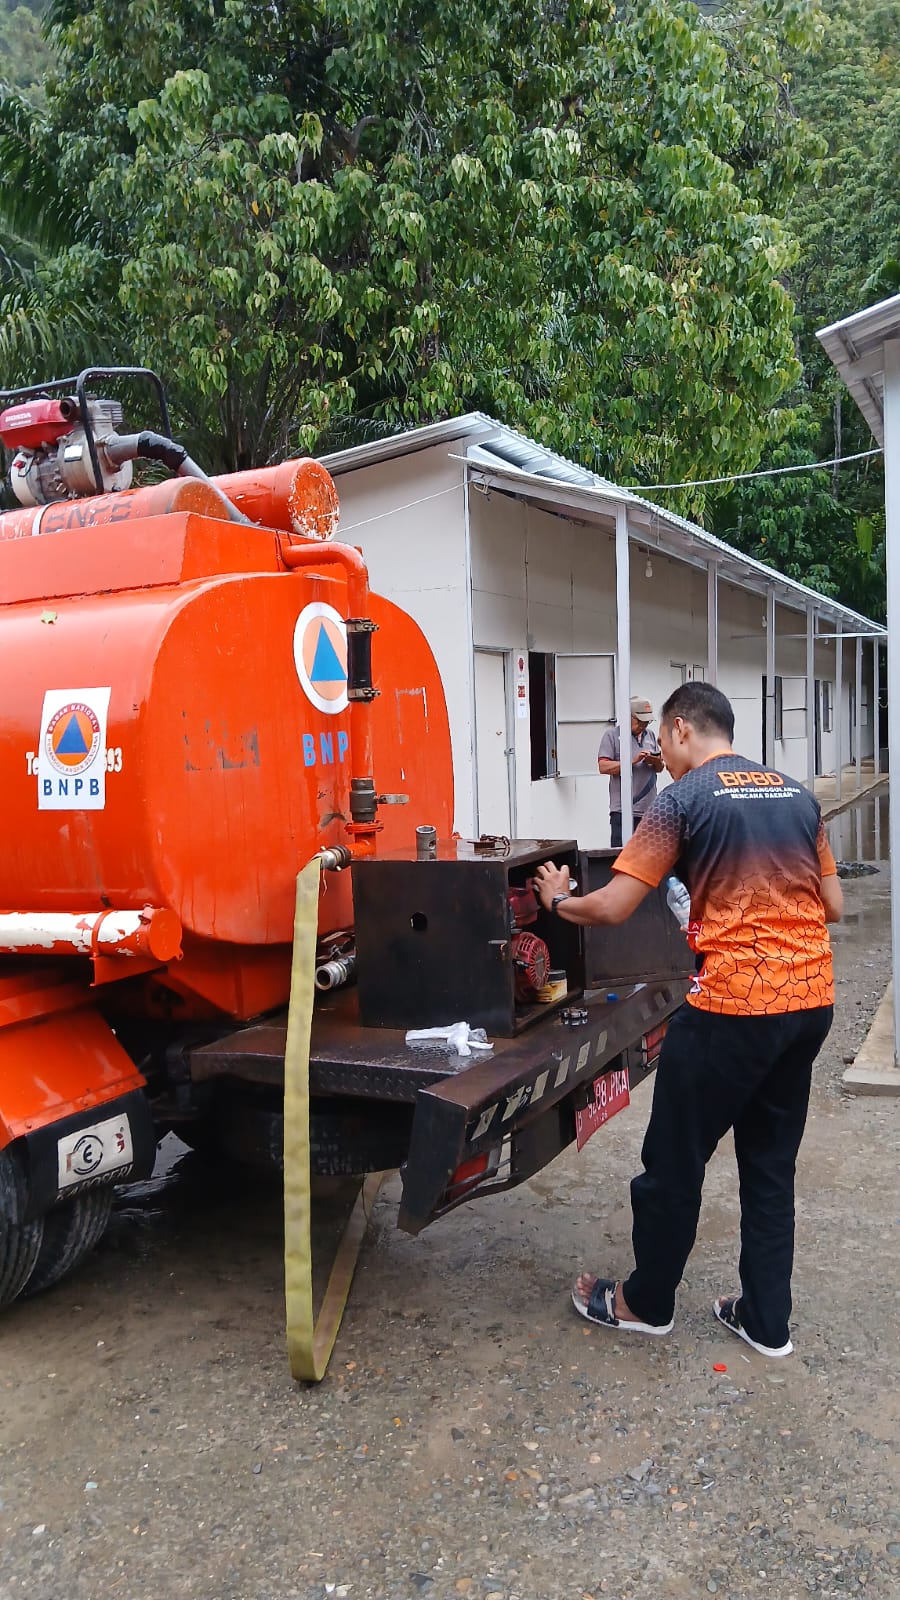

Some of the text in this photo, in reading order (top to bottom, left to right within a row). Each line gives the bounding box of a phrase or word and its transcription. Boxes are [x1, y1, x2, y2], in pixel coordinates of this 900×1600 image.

[105, 747, 122, 772] 93
[717, 771, 784, 786] BPBD
[43, 778, 100, 796] BNPB
[713, 787, 739, 797] BADAN
